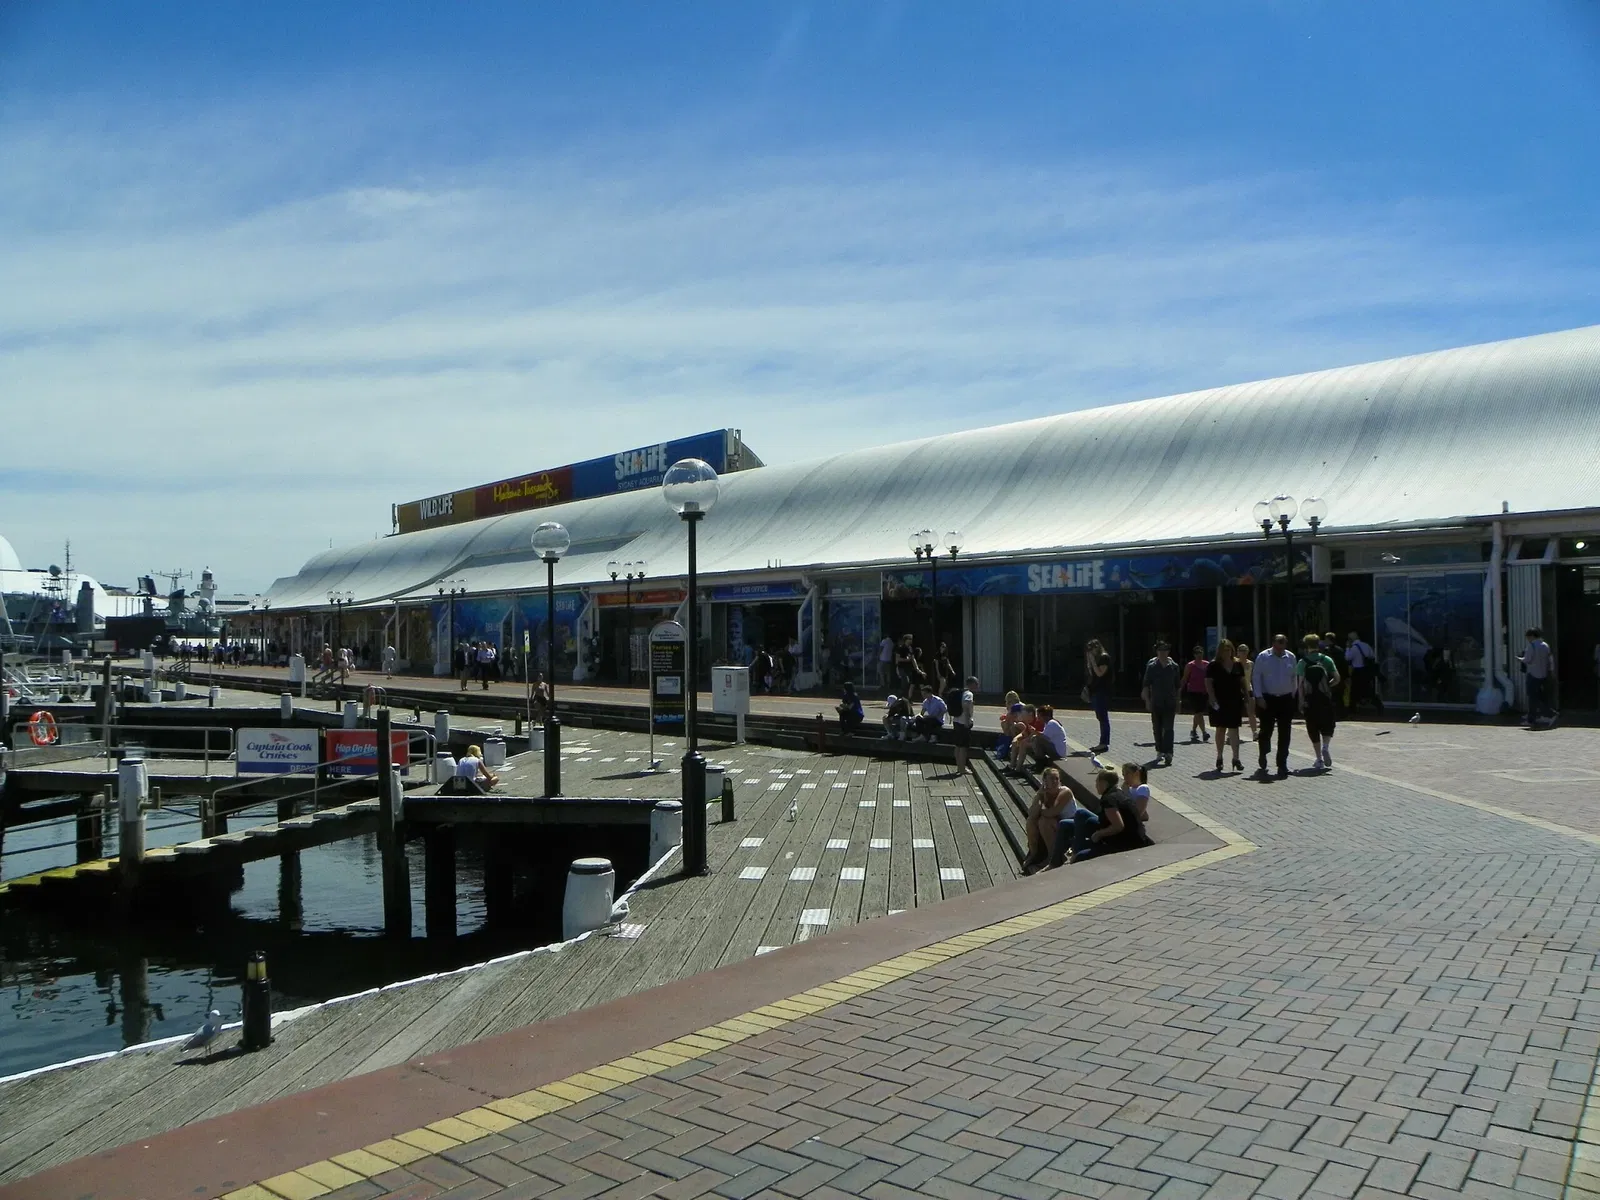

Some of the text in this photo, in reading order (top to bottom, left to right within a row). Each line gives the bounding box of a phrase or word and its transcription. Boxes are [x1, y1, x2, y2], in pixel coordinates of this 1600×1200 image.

[639, 474, 664, 486] AQUARIU
[420, 493, 453, 520] WILD LIFE
[246, 741, 312, 753] Captain Cook
[335, 743, 351, 753] Hop
[351, 743, 363, 753] On
[259, 750, 298, 760] Cruises
[329, 765, 352, 774] HERE
